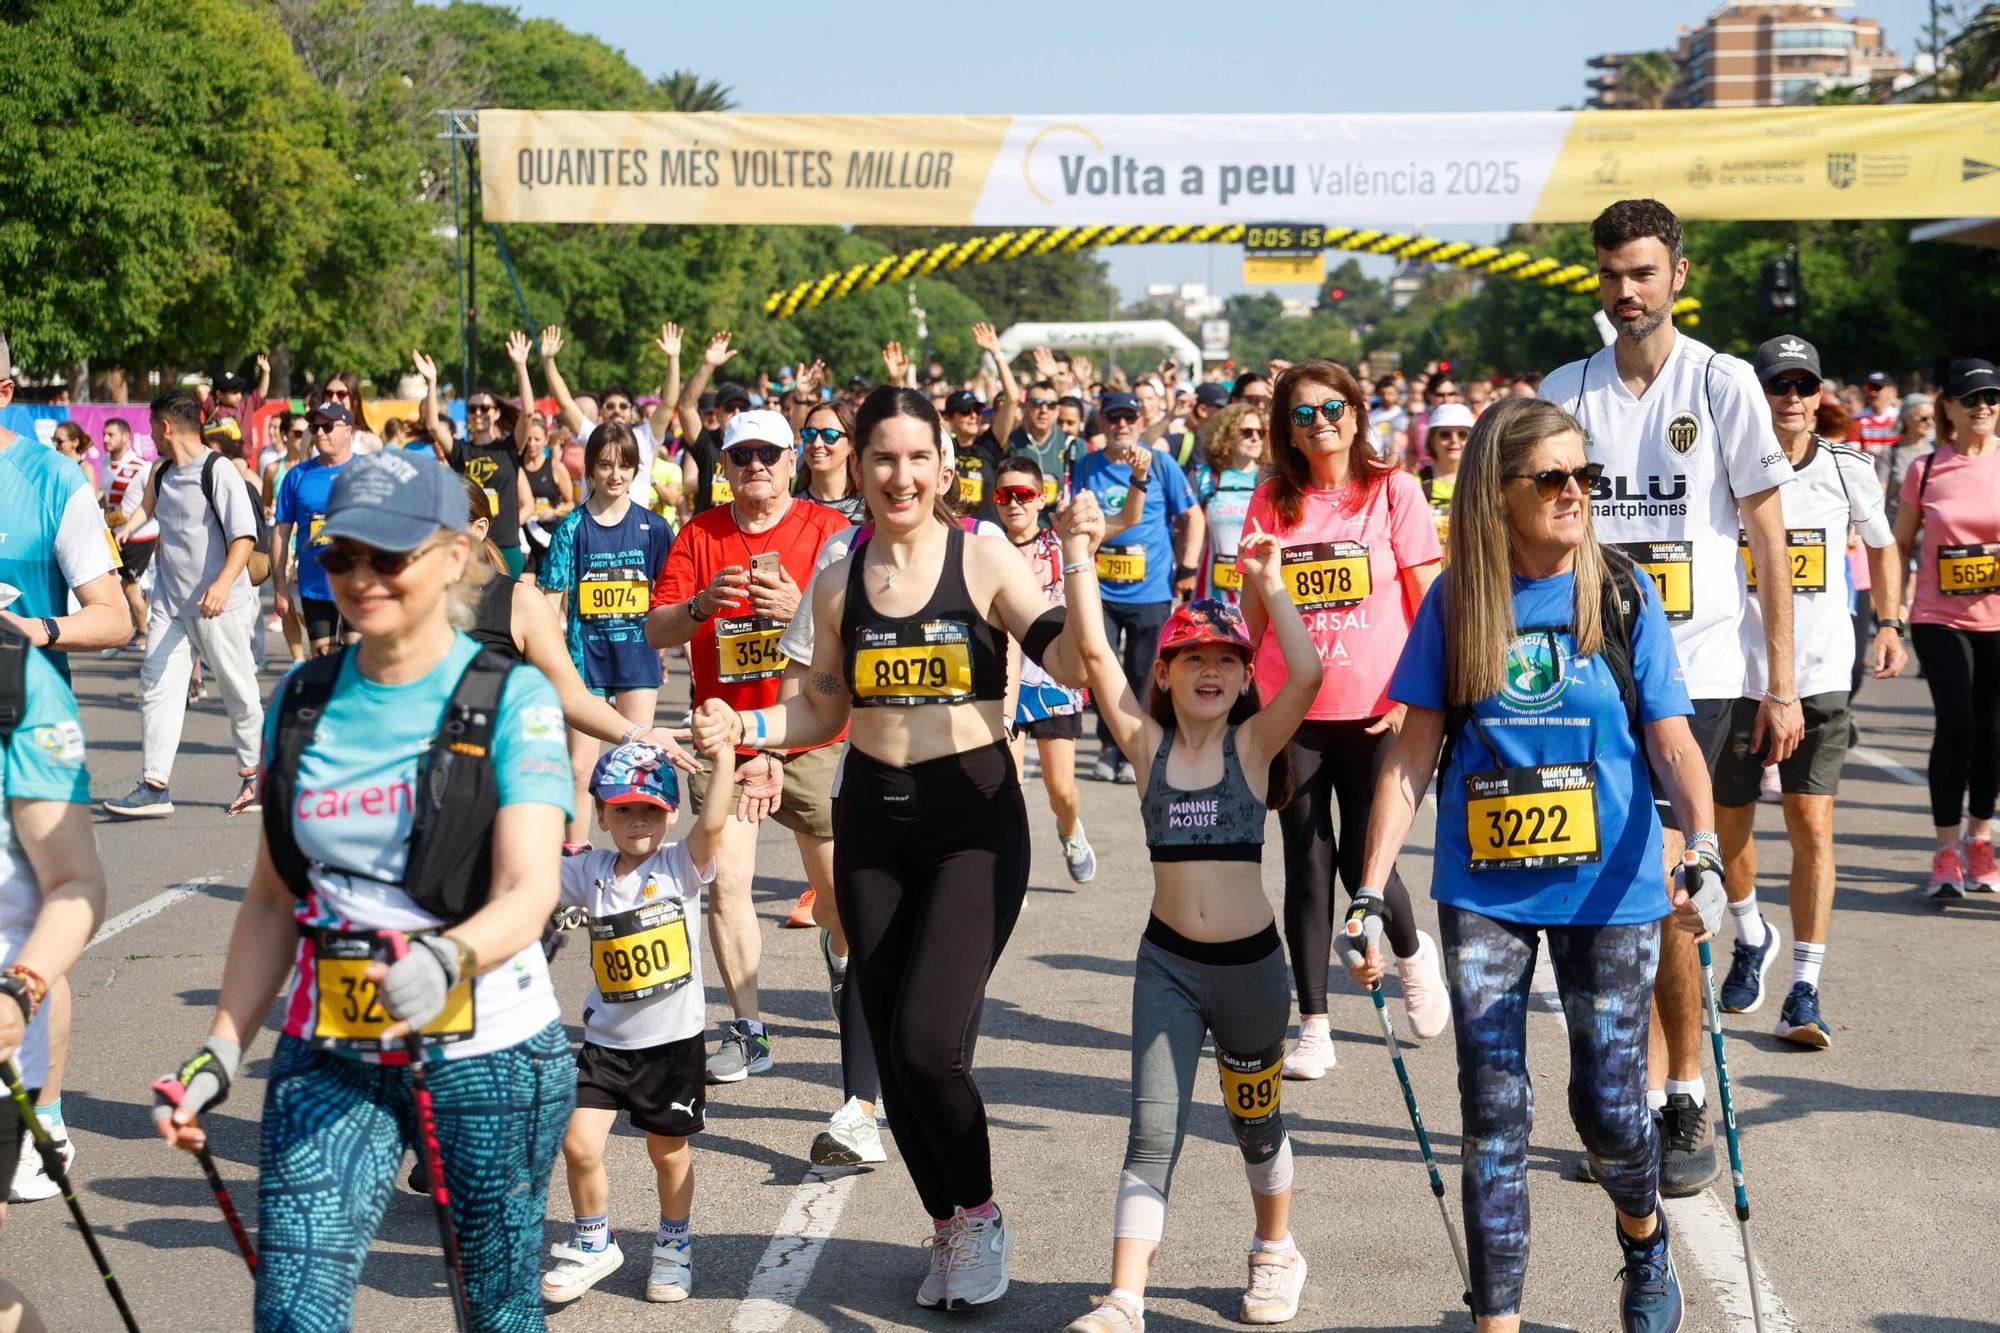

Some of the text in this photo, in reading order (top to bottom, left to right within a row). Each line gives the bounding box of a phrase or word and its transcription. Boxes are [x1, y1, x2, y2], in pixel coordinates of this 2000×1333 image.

[517, 140, 954, 190] QUANTES MÉS VOLTES MILLOR
[1059, 155, 1520, 205] Volta a peu València 2025
[1107, 560, 1132, 575] 7911
[1224, 568, 1241, 583] 79
[1952, 562, 1996, 584] 5657
[1296, 566, 1352, 597] 8978
[592, 588, 637, 608] 9074
[875, 657, 947, 688] 8979
[1495, 779, 1508, 790] peu
[1168, 800, 1219, 815] MINNIE
[1169, 814, 1218, 829] MOUSE
[1485, 804, 1571, 849] 3222
[602, 939, 670, 983] 8980
[1223, 1054, 1240, 1067] Volta
[1247, 1058, 1262, 1068] peu
